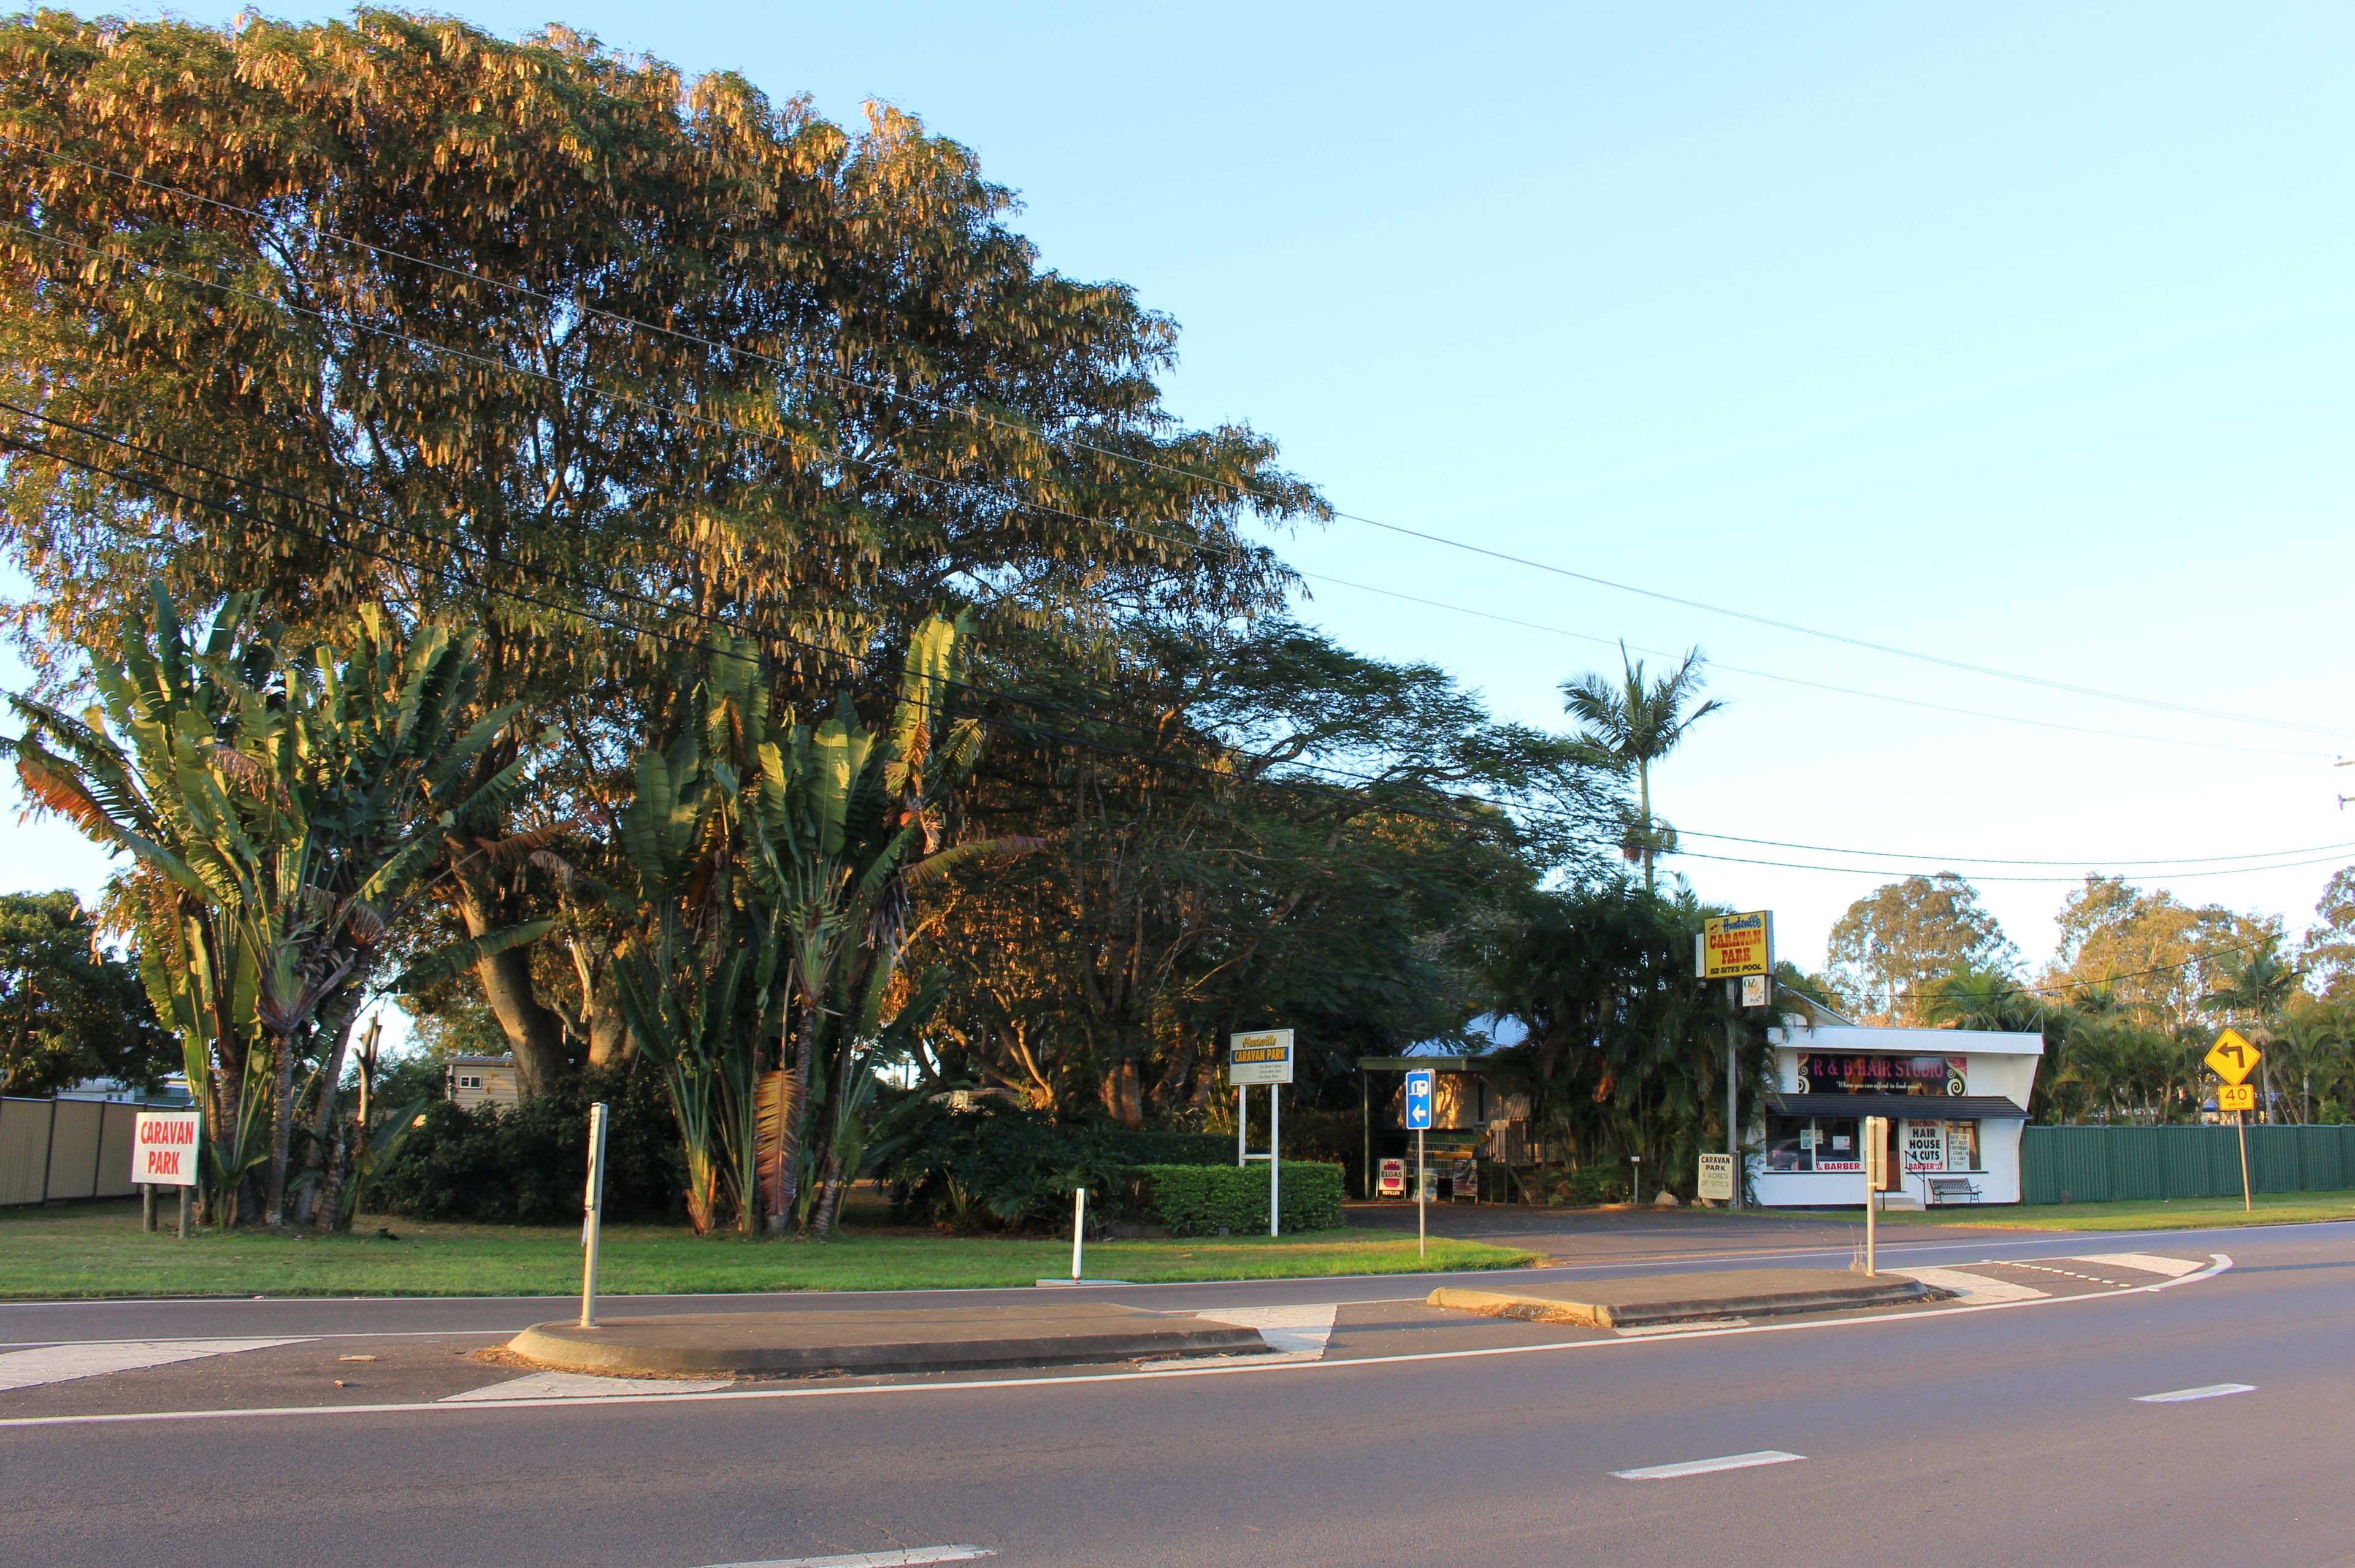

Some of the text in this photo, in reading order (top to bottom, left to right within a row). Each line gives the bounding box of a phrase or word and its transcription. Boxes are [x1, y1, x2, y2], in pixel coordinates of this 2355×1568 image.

[1723, 915, 1761, 933] Huntsville
[1710, 930, 1761, 949] CARAVAN
[1721, 947, 1751, 965] PARK
[1744, 978, 1757, 988] OZ
[1243, 1034, 1276, 1048] Huntsville
[1235, 1048, 1285, 1063] CARAVAN PARK
[1813, 1058, 1943, 1077] R & B HAIR STUDIO
[1874, 1082, 1889, 1090] afford
[2225, 1088, 2247, 1101] 40
[141, 1121, 194, 1144] CARAVAN
[1913, 1128, 1936, 1138] HAIR
[1910, 1140, 1940, 1149] HOUSE
[148, 1151, 180, 1174] PARK
[1920, 1151, 1939, 1160] CUTS
